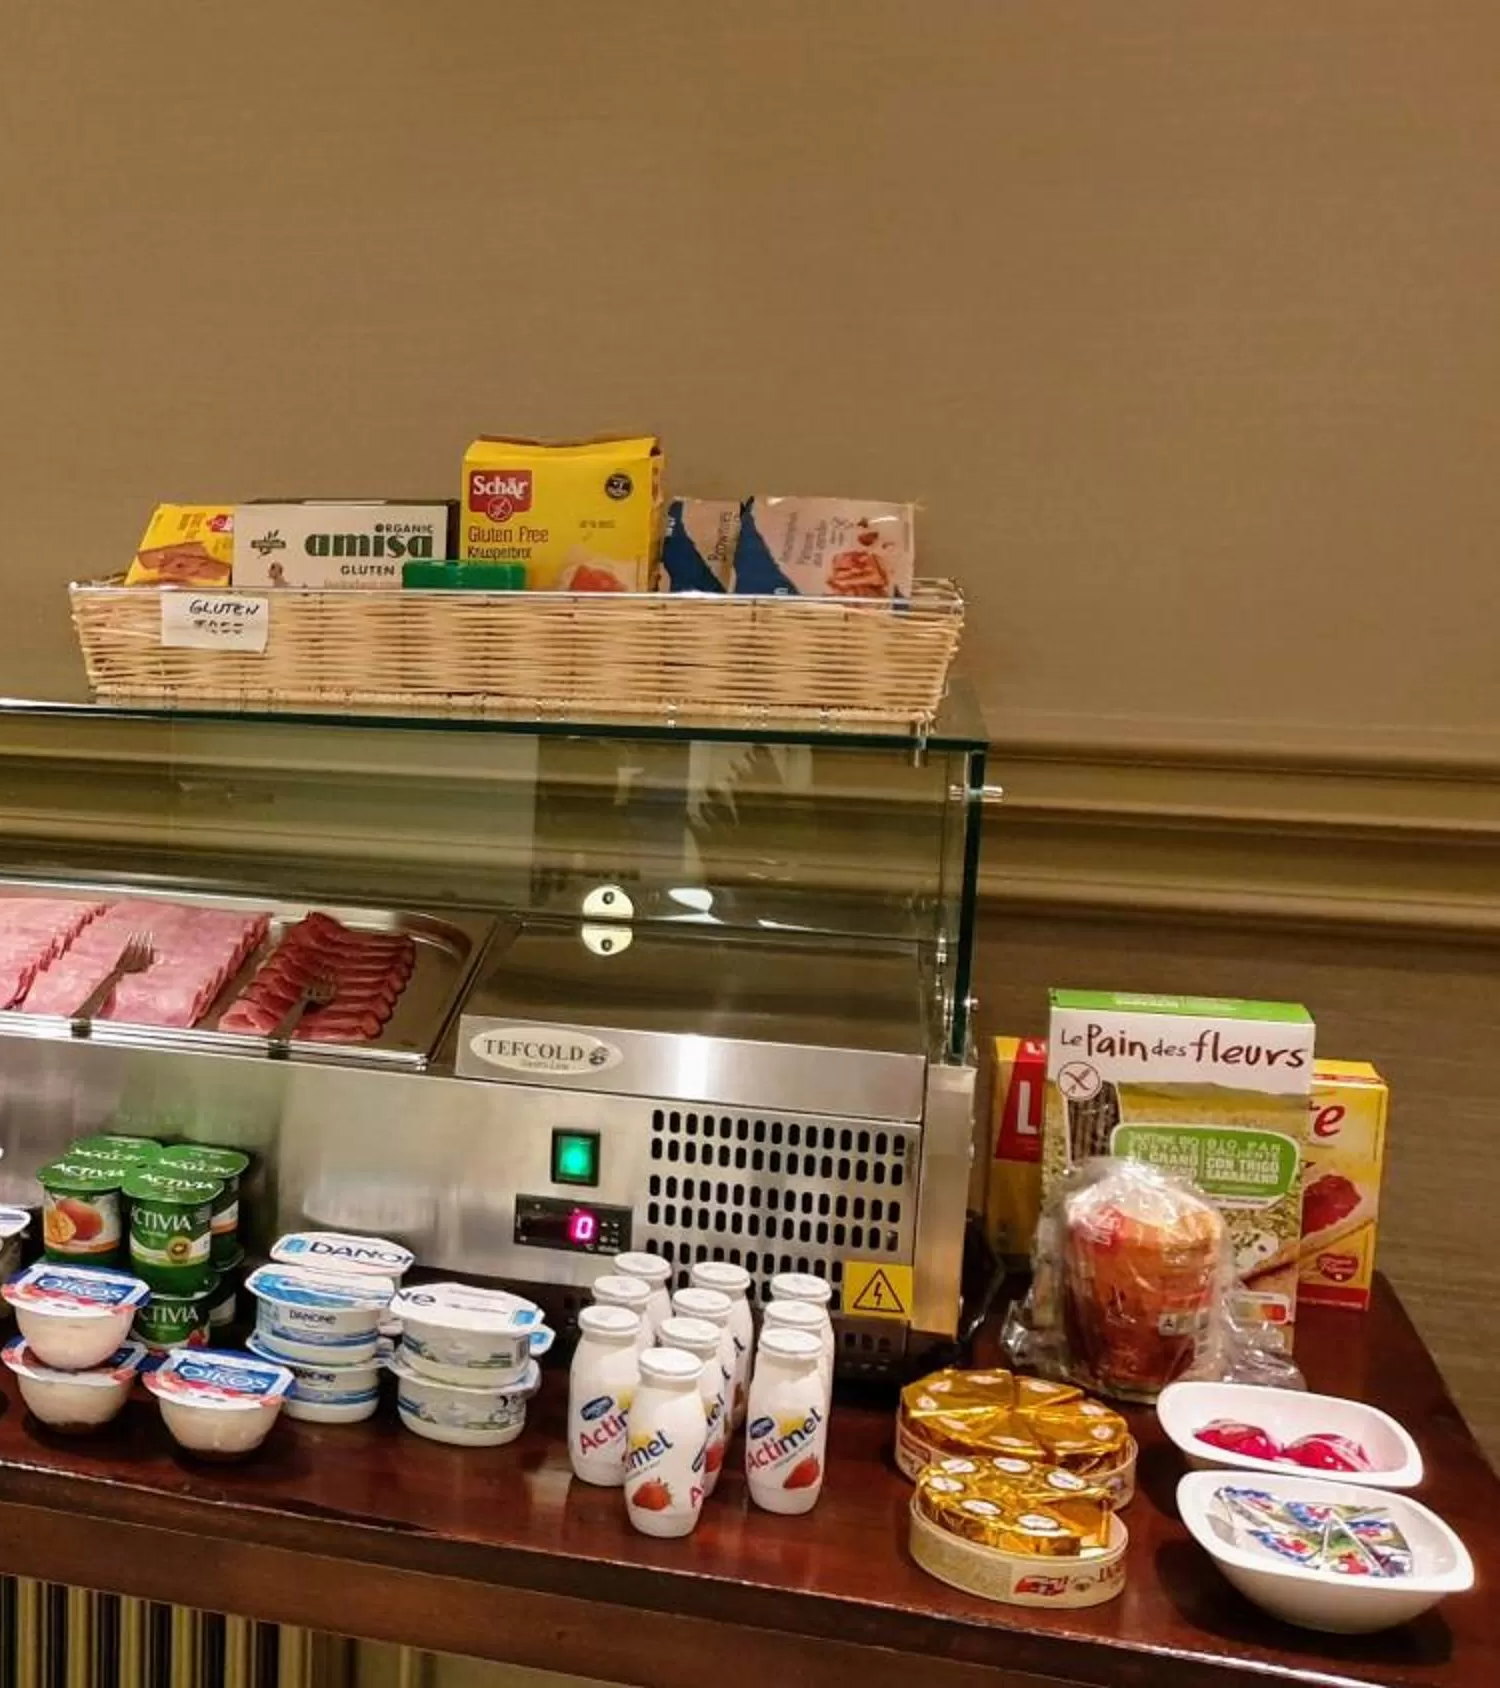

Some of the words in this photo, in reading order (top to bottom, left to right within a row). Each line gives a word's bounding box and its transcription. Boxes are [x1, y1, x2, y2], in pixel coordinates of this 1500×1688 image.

[473, 475, 529, 498] Schär
[375, 523, 435, 534] ORGANIC
[468, 526, 512, 543] Gluten
[519, 526, 549, 543] Free
[305, 531, 433, 558] amisa
[340, 565, 395, 576] GLUTEN
[189, 600, 260, 615] GLUTEN
[484, 1039, 584, 1061] TEFCOLD
[1061, 1029, 1082, 1047] Le
[1087, 1024, 1148, 1061] Pain
[1152, 1039, 1187, 1057] des
[1190, 1030, 1308, 1068] fleurs
[1206, 1157, 1235, 1171] CON
[1239, 1159, 1280, 1174] TRIGO
[575, 1216, 593, 1239] 0
[748, 1407, 823, 1471] Actimel
